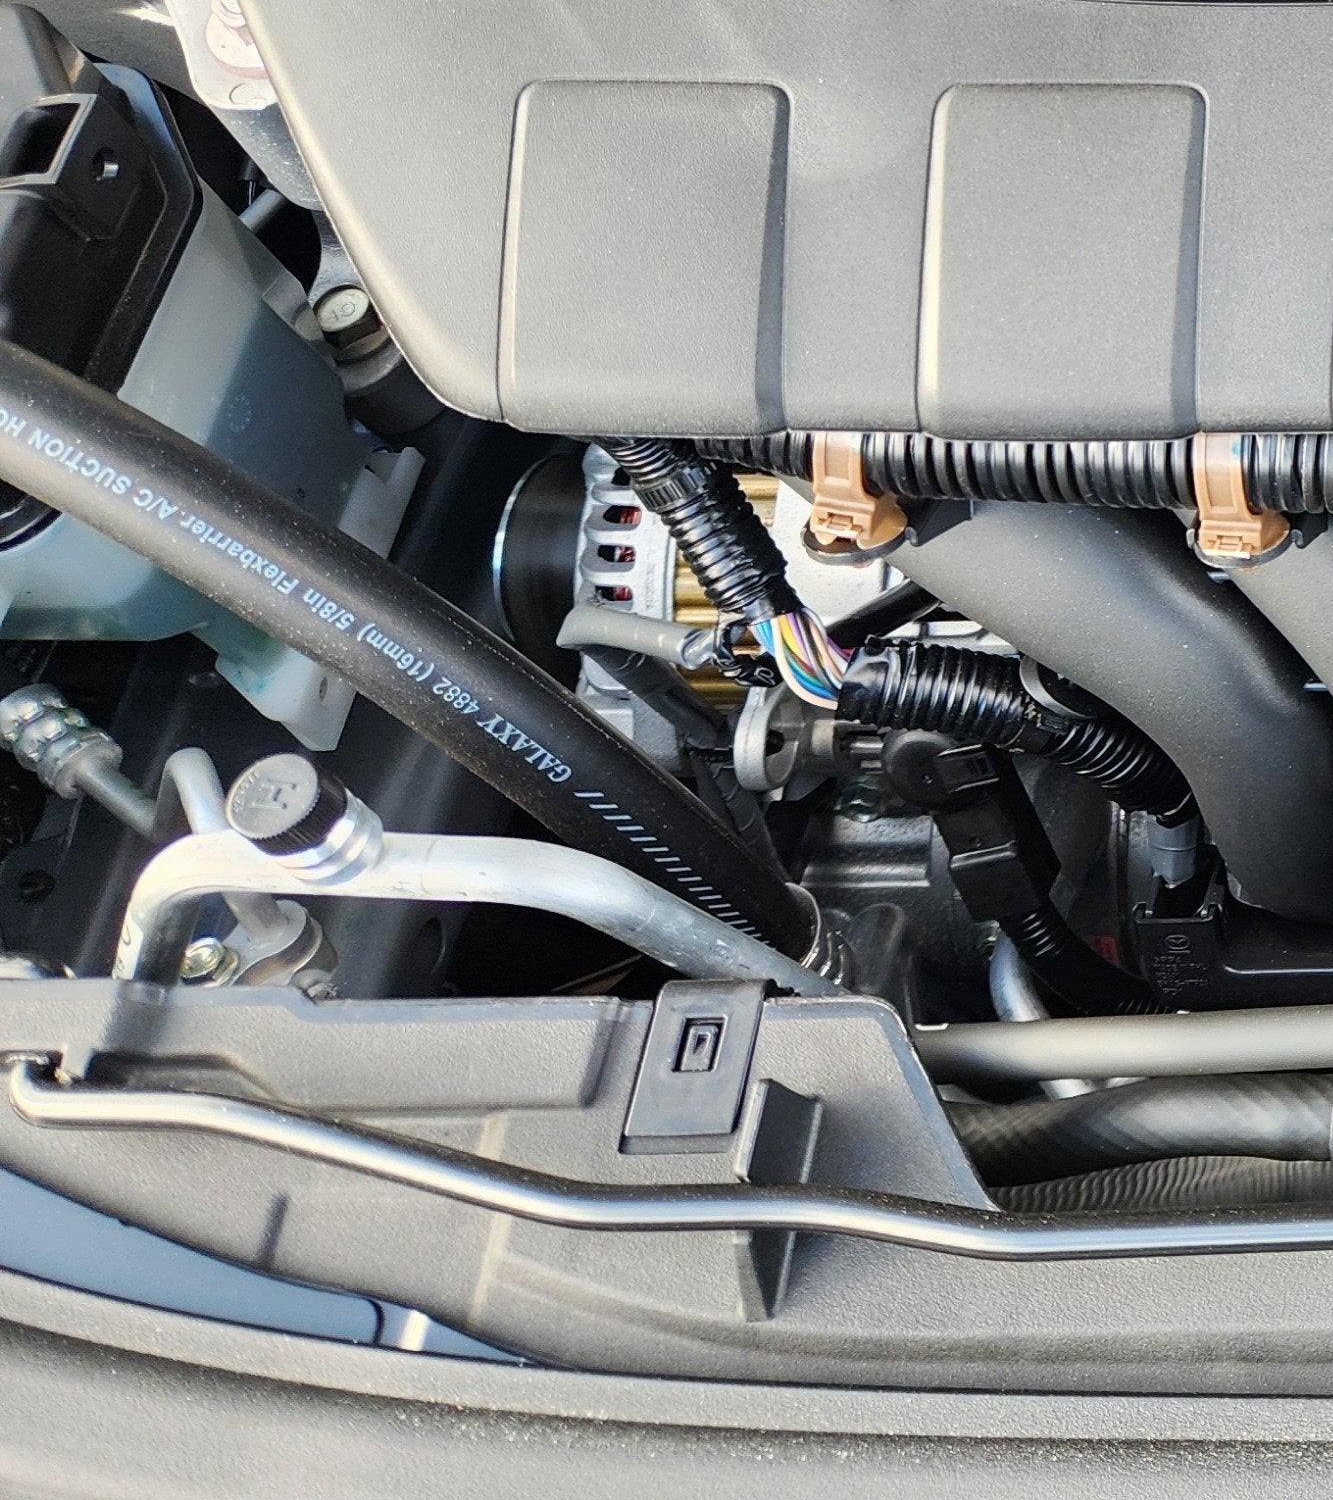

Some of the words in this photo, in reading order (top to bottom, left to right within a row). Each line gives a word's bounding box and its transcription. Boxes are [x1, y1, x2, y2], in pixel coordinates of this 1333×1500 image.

[27, 426, 132, 495] SUCTION
[132, 488, 180, 520] A/C
[180, 514, 299, 596] Flexbarrier
[303, 587, 355, 631] 5/8in
[356, 622, 435, 683] (16mm)
[432, 676, 480, 714] 4882
[476, 713, 572, 783] GALAXY
